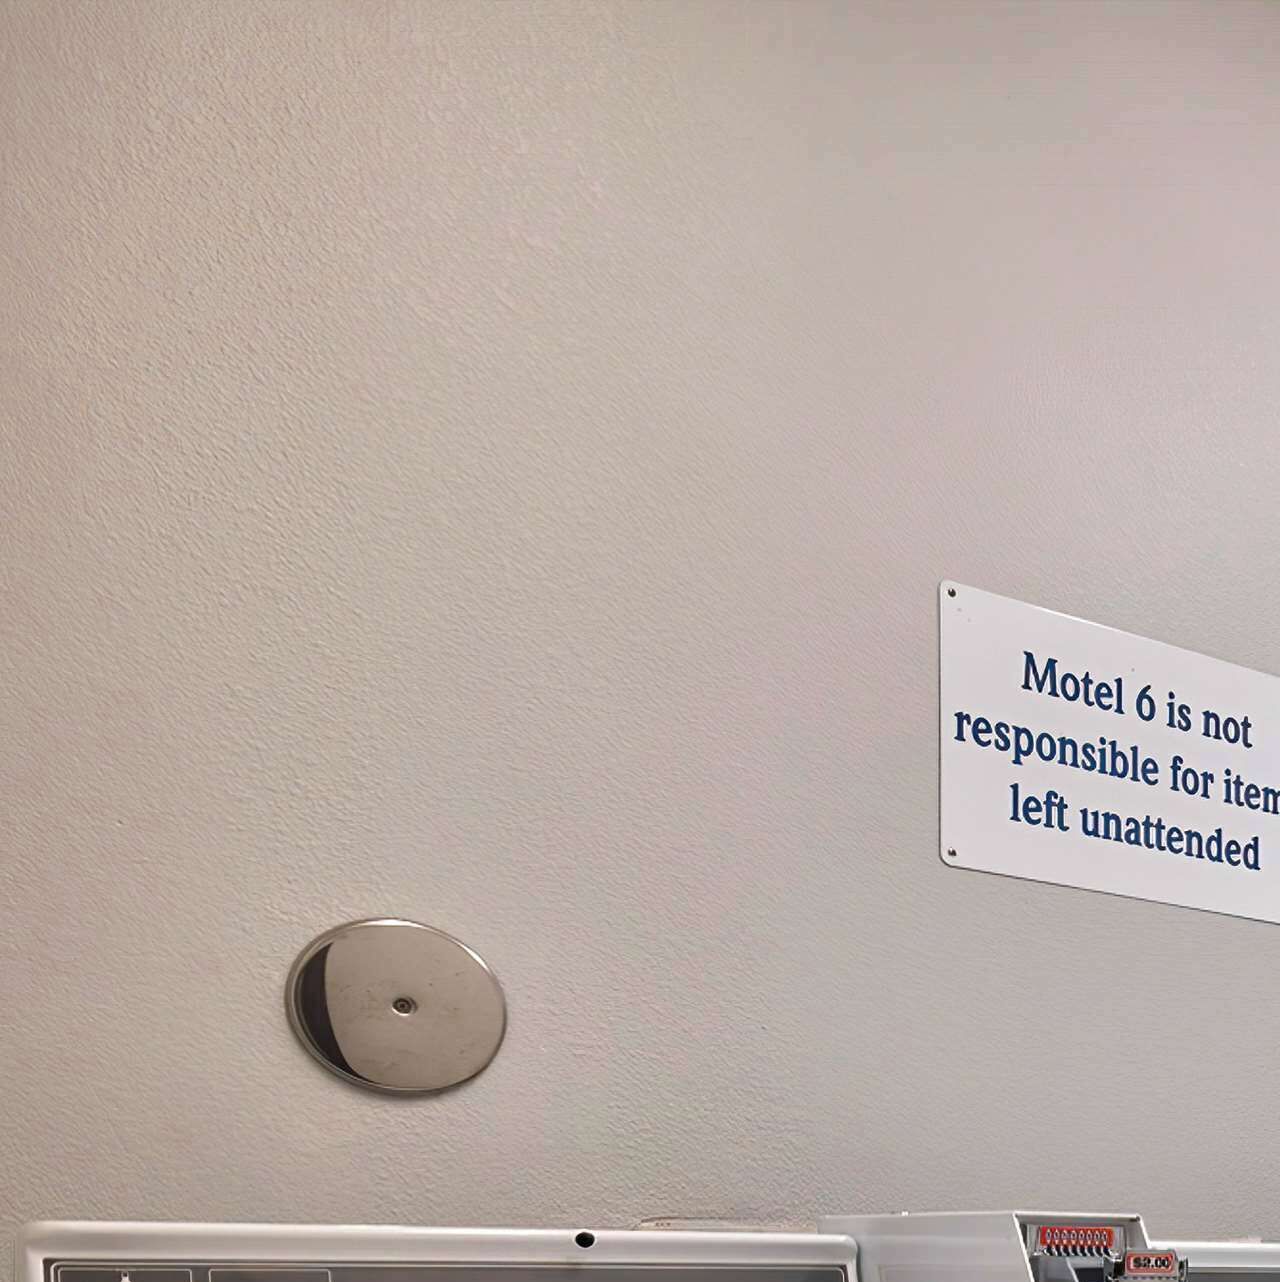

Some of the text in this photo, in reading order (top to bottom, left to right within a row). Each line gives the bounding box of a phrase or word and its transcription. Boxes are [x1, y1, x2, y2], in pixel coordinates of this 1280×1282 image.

[1021, 650, 1254, 749] Motel 6 is not
[953, 711, 1160, 786] responsible
[1169, 755, 1215, 799] for
[1009, 782, 1262, 871] left unattended
